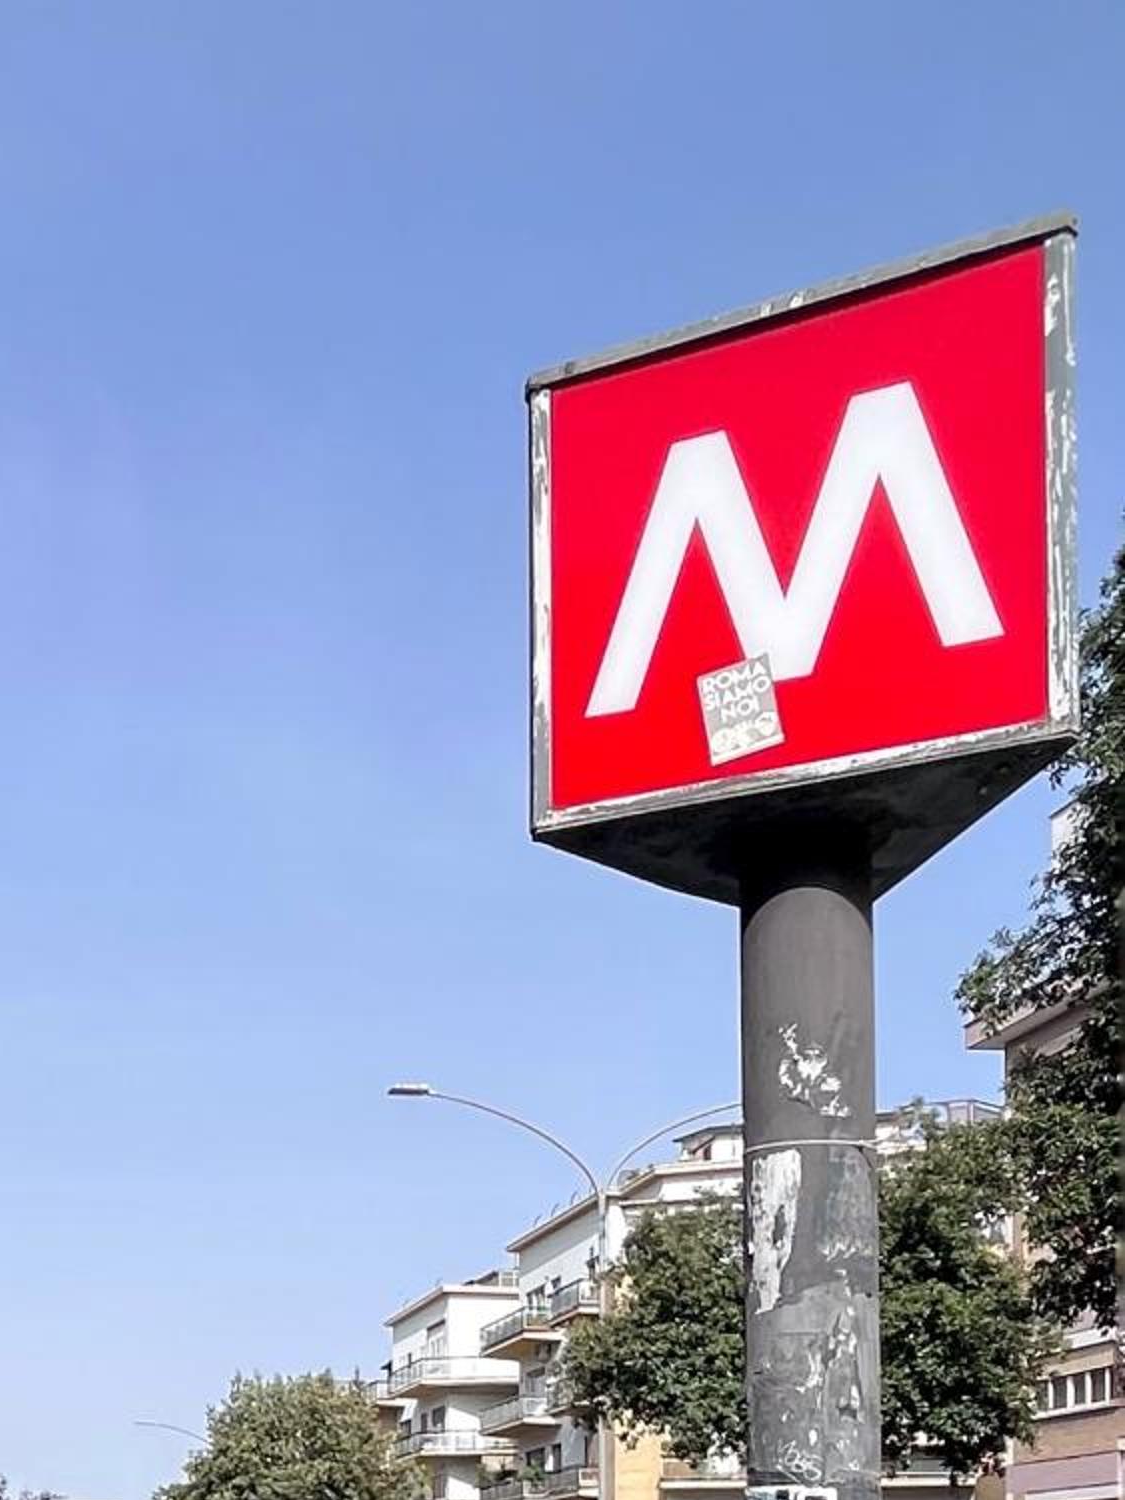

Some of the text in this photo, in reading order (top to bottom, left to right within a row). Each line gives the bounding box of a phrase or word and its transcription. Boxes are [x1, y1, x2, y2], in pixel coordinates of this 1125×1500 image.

[584, 380, 1005, 718] M
[702, 660, 765, 693] ROMA
[703, 676, 771, 711] SIAMO
[720, 695, 760, 724] NOI
